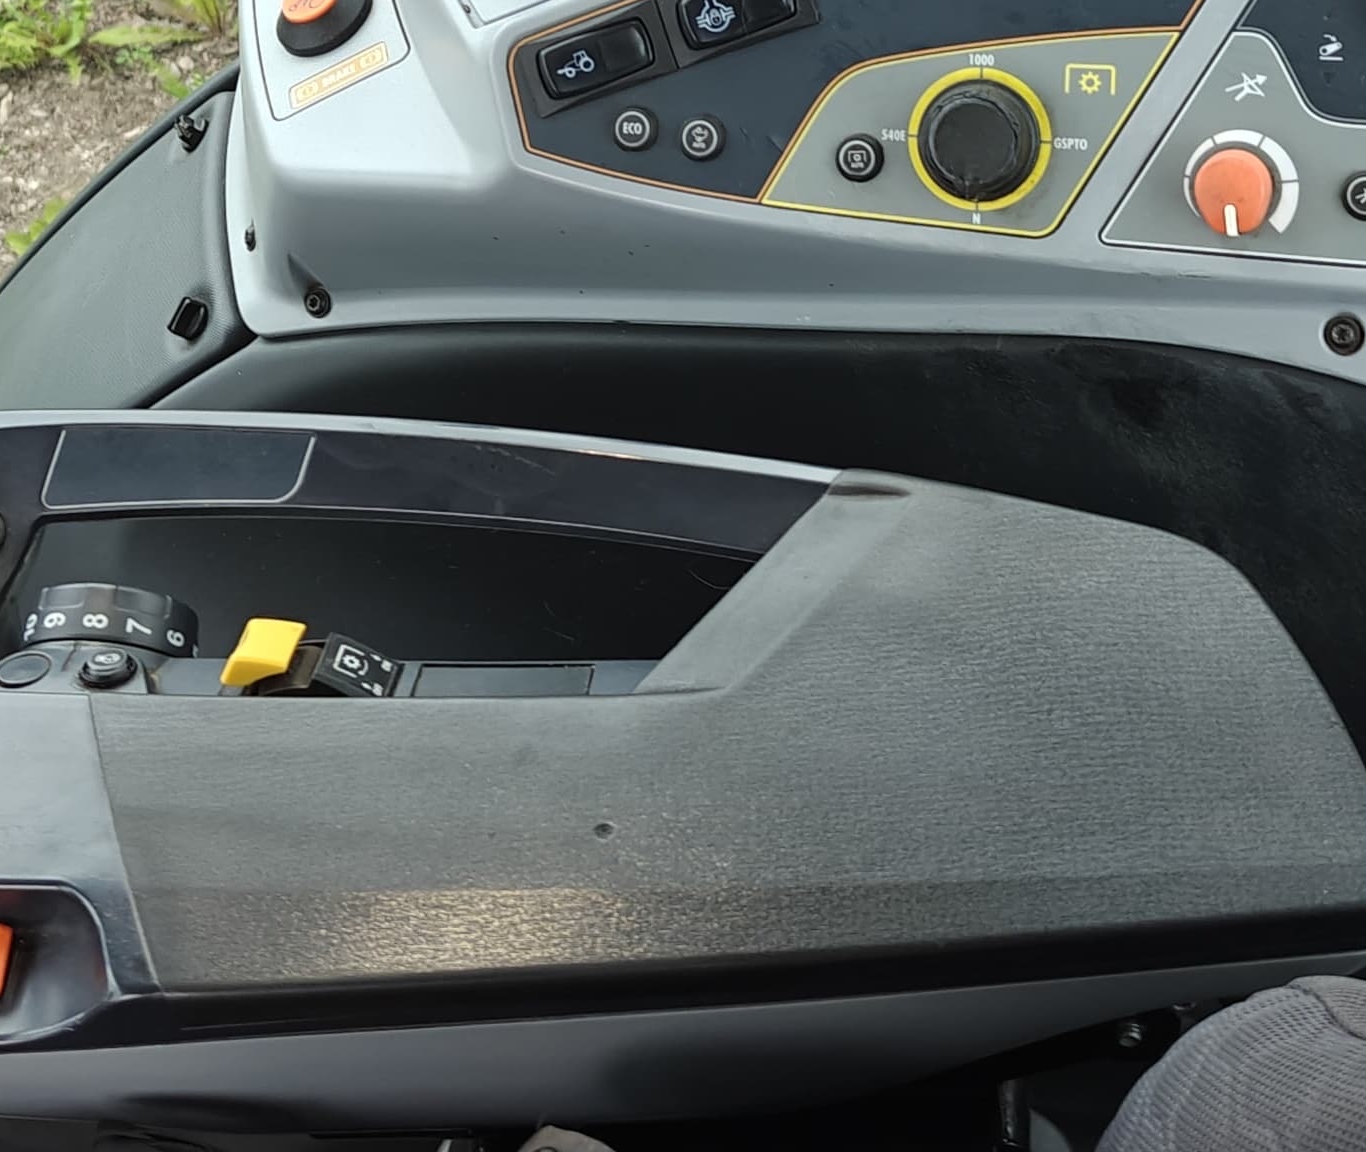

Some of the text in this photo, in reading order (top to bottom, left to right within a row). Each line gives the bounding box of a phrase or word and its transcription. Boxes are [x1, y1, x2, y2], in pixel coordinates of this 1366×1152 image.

[968, 53, 995, 66] 1000
[622, 121, 643, 135] ECO
[1053, 137, 1088, 151] GSPTO
[972, 213, 981, 224] N
[43, 612, 66, 628] 9
[82, 613, 109, 629] 8
[125, 617, 153, 636] 7
[166, 629, 184, 647] 6
